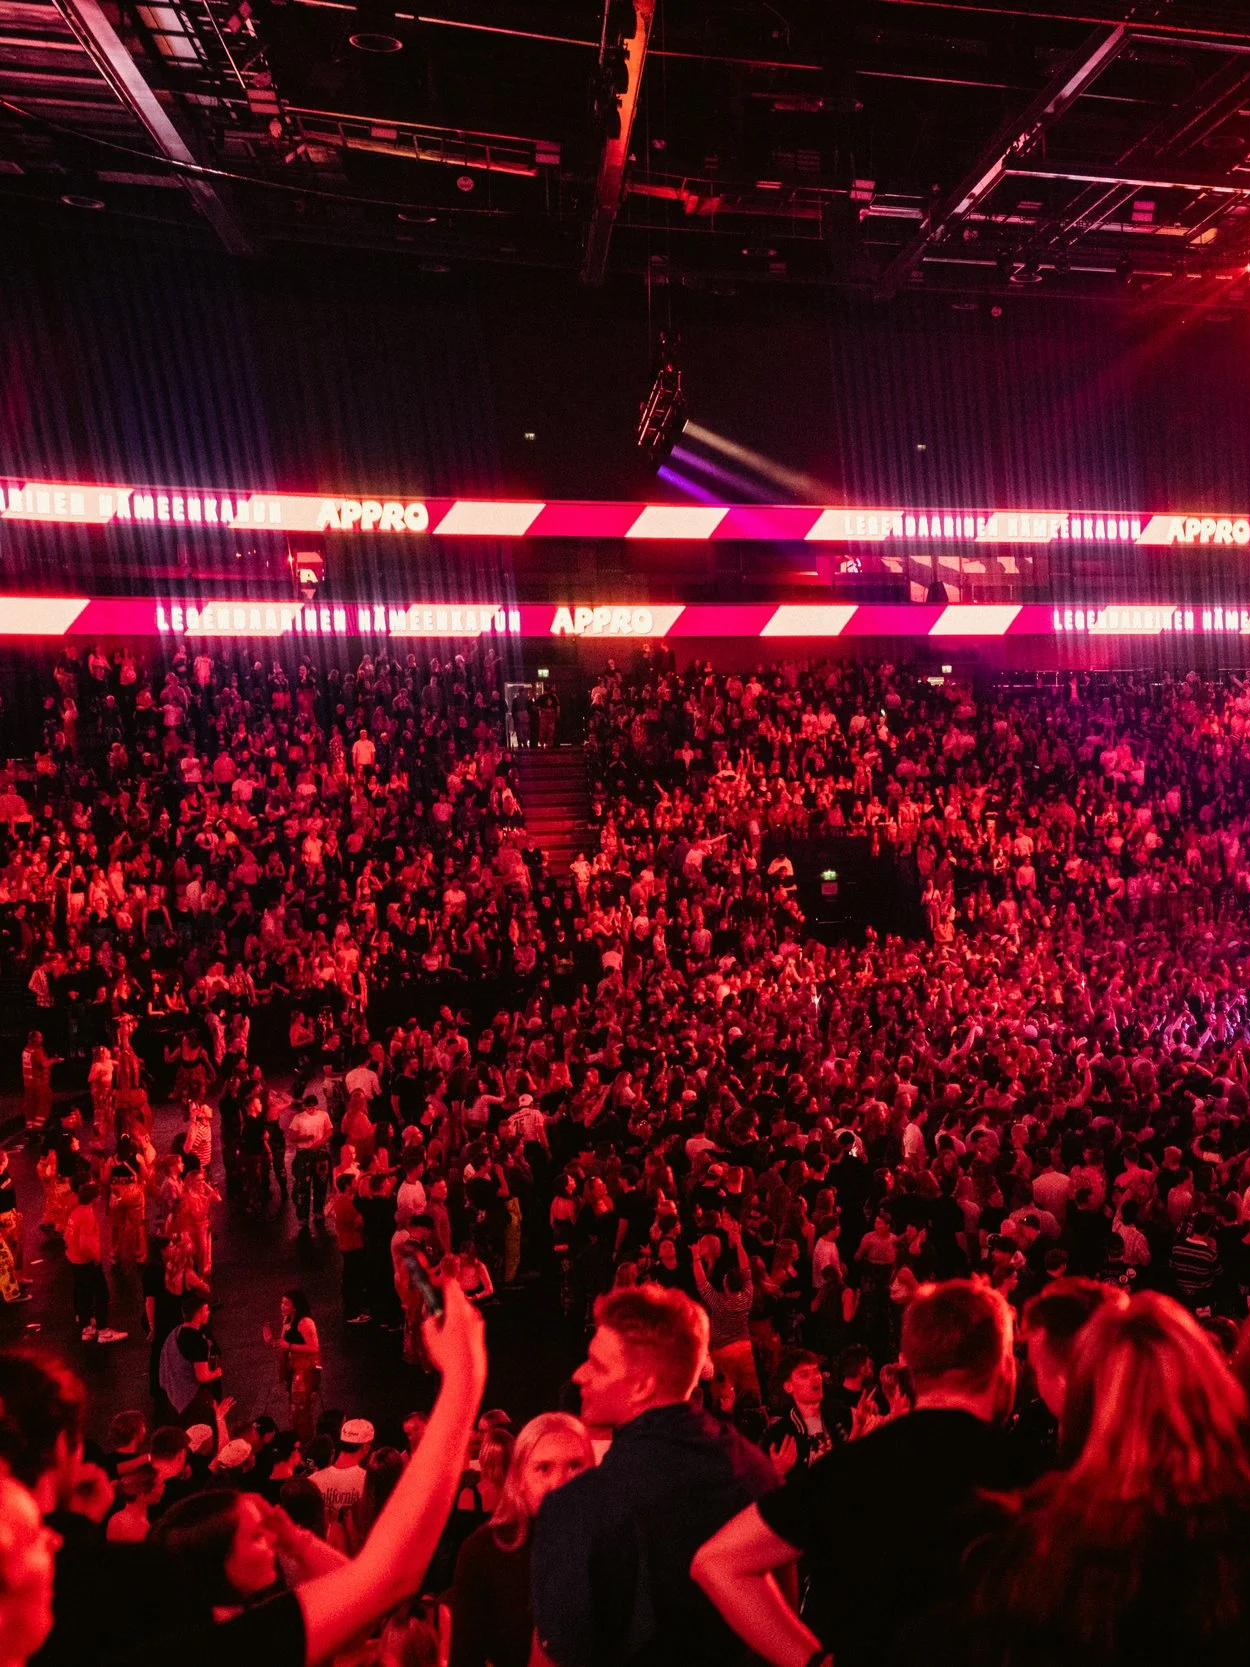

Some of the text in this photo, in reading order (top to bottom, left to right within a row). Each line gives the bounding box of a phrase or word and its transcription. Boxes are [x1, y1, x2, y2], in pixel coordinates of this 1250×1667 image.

[316, 500, 429, 532] APPRO
[1167, 517, 1250, 544] APPRO
[550, 606, 654, 635] APPRO
